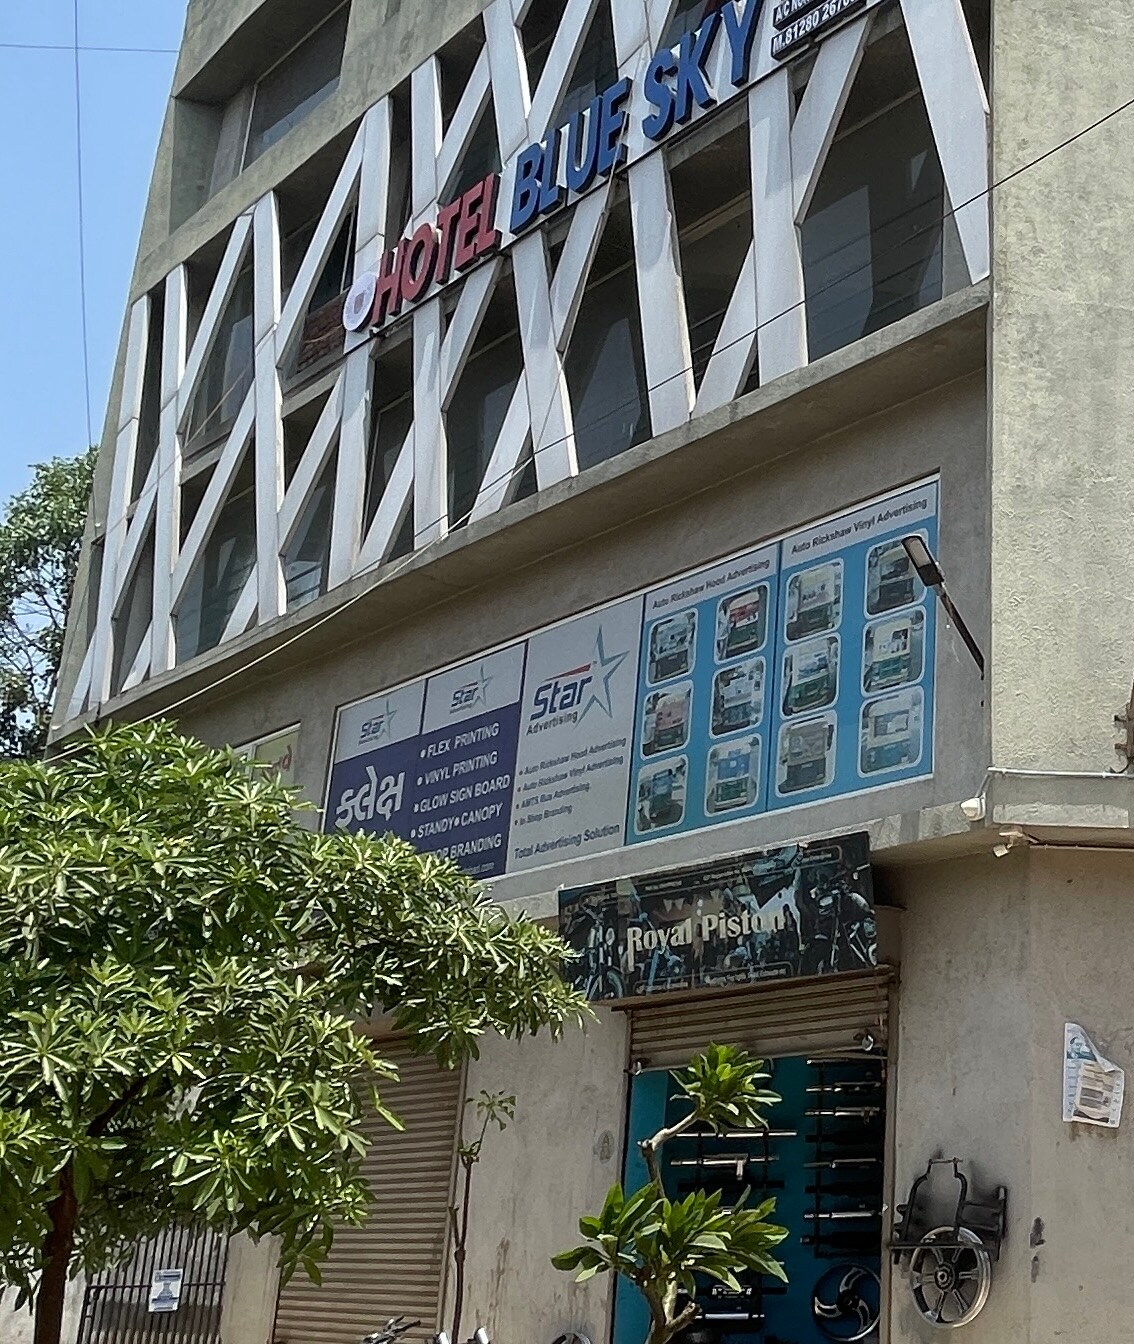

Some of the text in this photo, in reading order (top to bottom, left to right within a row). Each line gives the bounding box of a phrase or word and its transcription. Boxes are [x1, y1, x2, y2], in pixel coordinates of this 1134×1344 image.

[773, 11, 819, 54] M.81280
[371, 173, 500, 326] HOTEL
[510, 76, 633, 235] BLUE
[791, 542, 811, 554] Auto
[853, 516, 875, 532] Vinyl
[876, 498, 928, 523] Advertising
[451, 685, 478, 707] Star
[530, 674, 593, 721] Star
[427, 722, 500, 757] FLEX PRINTING
[526, 711, 578, 736] Advertising
[424, 751, 498, 785] VINYL PRINTING
[420, 774, 511, 813] GLOW SIGN BOARD
[417, 802, 503, 838] STANDY CANOPY
[583, 824, 619, 842] Solution
[450, 833, 502, 859] BRANDING
[627, 908, 786, 972] Royal Piston
